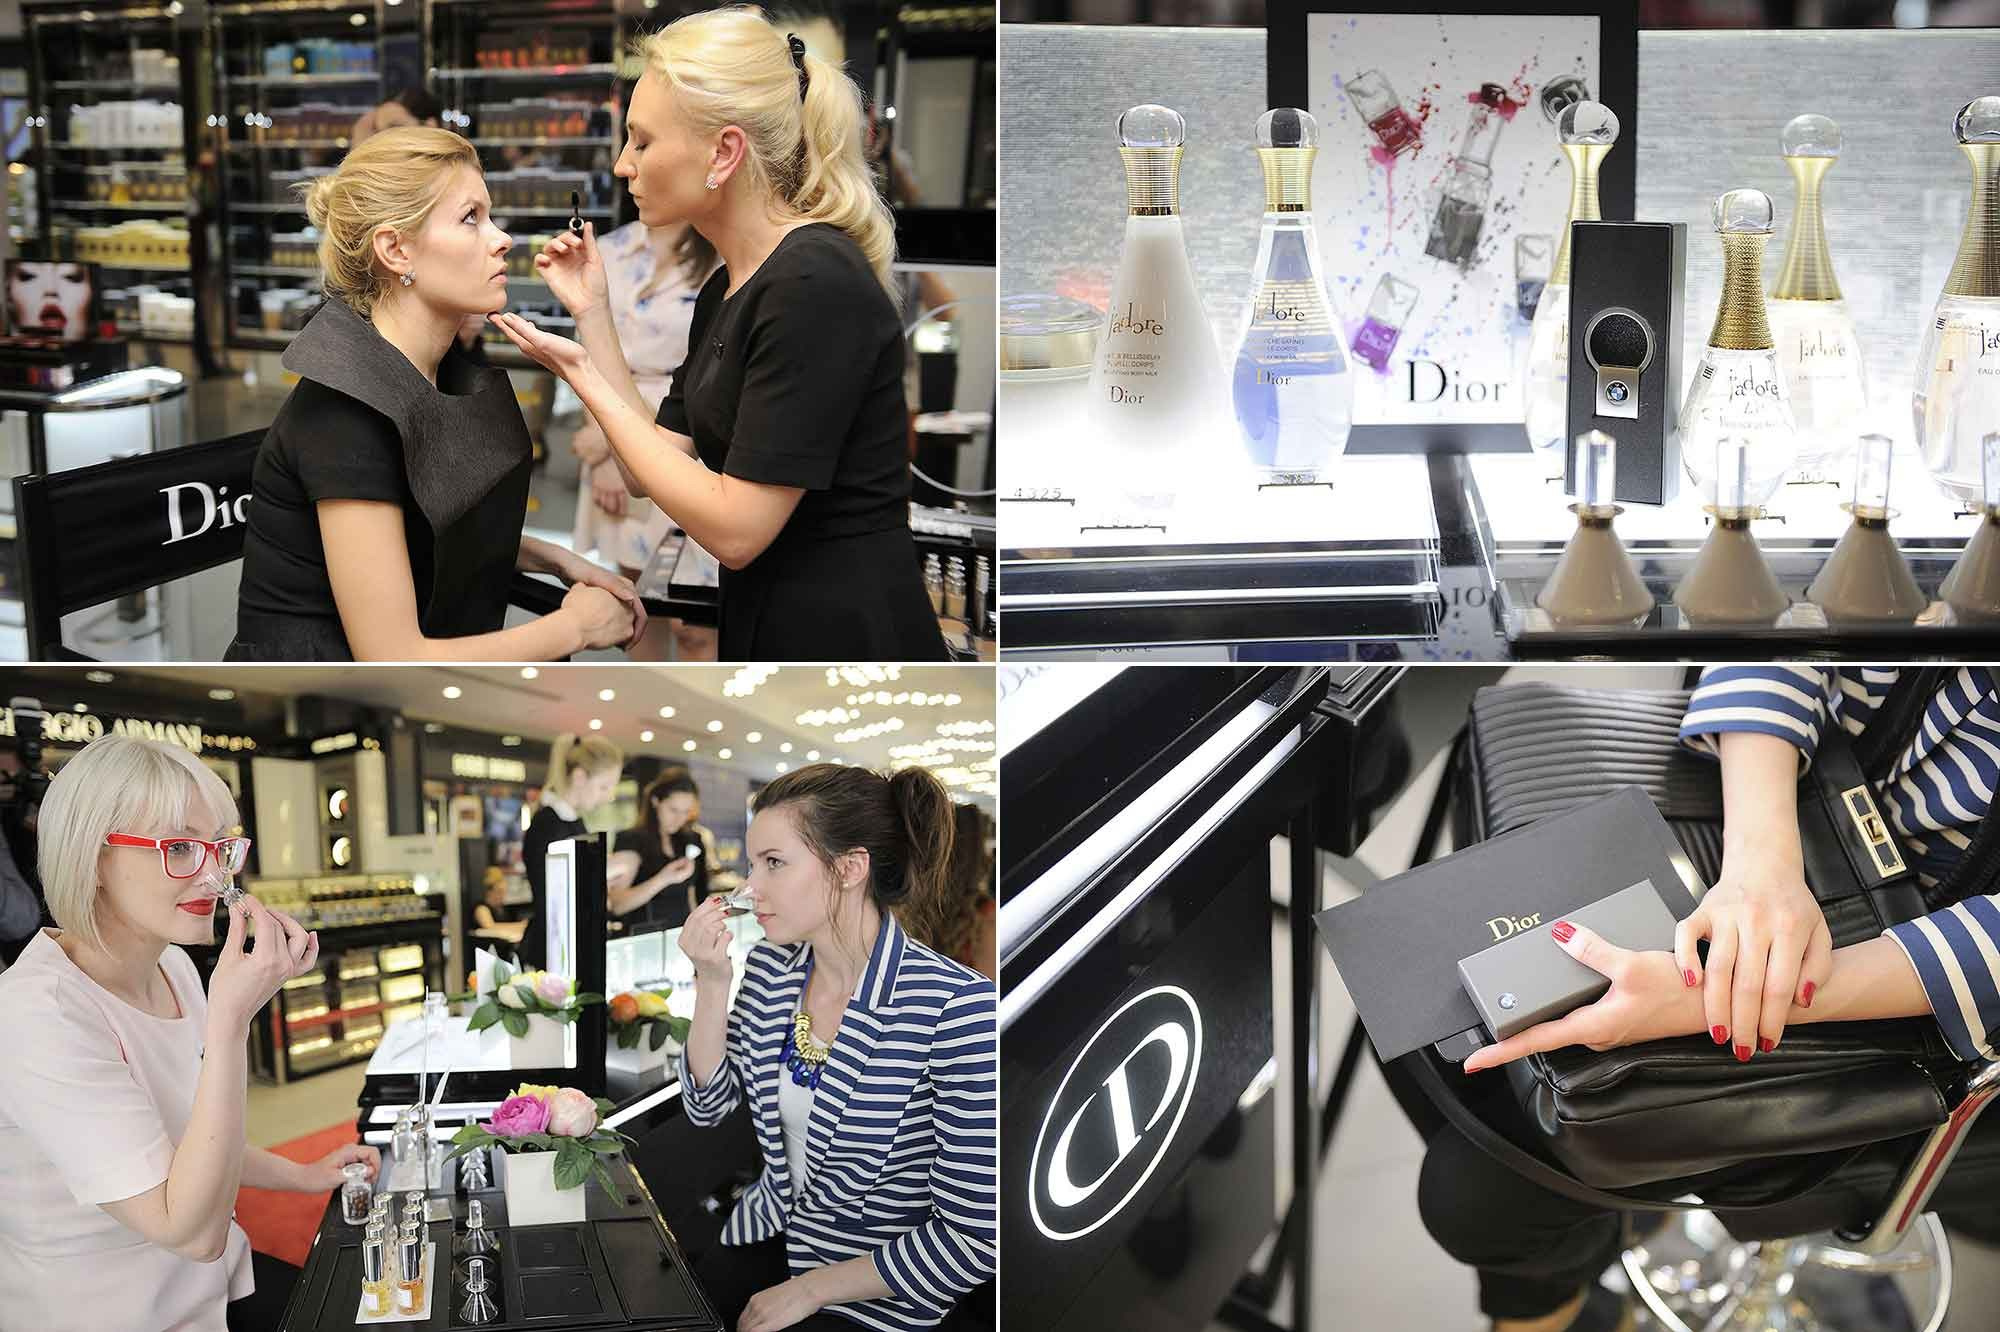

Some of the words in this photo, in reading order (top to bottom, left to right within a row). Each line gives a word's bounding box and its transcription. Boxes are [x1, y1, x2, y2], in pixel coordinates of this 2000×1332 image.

[1111, 385, 1145, 404] Dior
[1406, 359, 1507, 403] Dior
[159, 481, 254, 546] Dio
[1485, 912, 1541, 942] Dior
